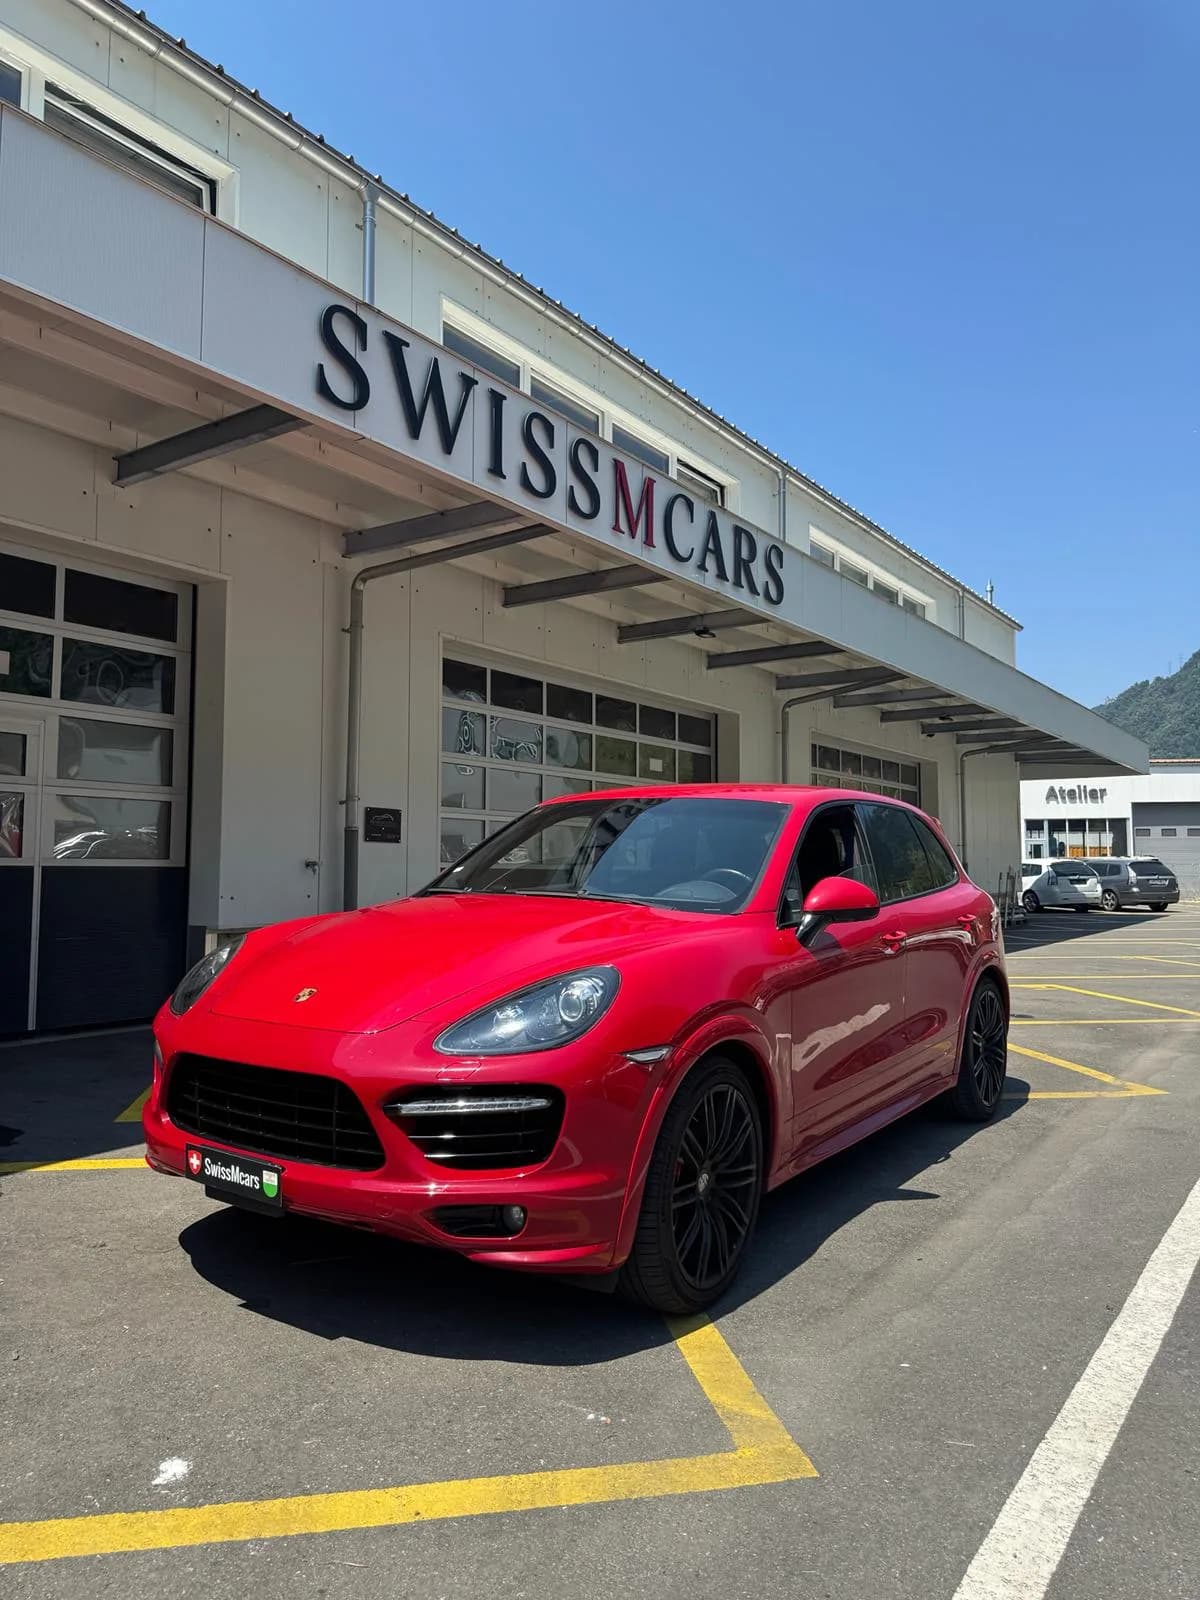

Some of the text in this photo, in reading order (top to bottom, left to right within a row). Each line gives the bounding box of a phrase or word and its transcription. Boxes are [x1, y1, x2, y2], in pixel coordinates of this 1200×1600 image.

[317, 304, 785, 605] SWISSMCARS
[1045, 785, 1108, 805] Atelier
[204, 1157, 261, 1190] SwissMcars
